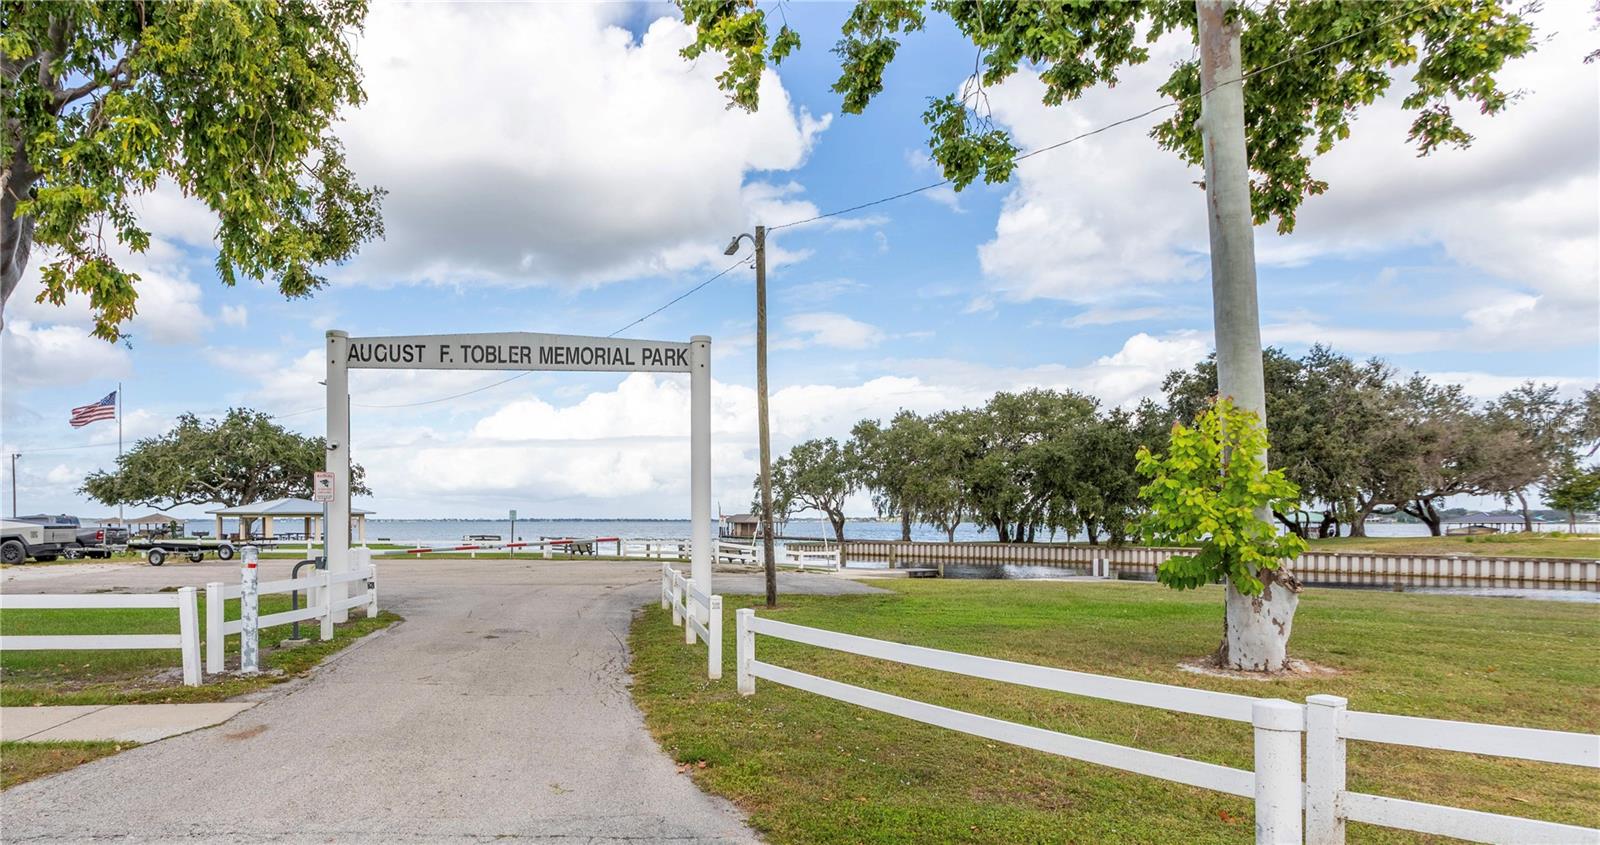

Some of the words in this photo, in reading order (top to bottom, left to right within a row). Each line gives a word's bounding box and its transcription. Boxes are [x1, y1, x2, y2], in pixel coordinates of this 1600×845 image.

[347, 343, 426, 362] AUGUST
[439, 344, 453, 363] F.
[460, 344, 532, 364] TOBLER
[539, 346, 636, 366] MEMORIAL
[642, 347, 688, 367] PARK
